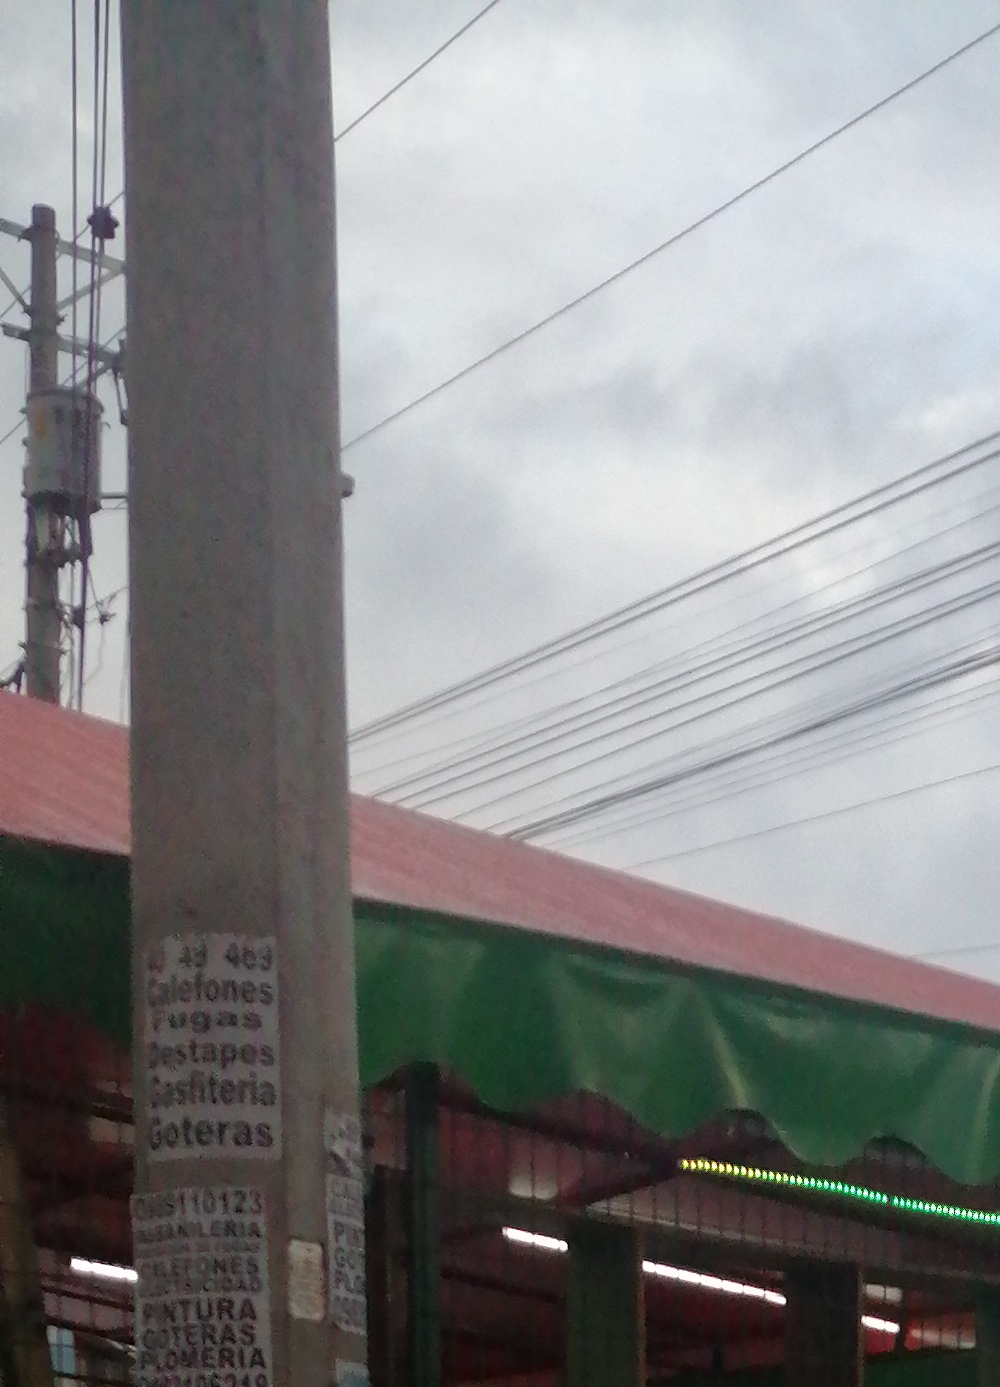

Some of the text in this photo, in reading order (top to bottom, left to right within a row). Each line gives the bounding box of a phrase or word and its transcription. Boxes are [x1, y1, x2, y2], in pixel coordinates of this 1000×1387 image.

[150, 1114, 274, 1151] Goteras
[142, 1297, 258, 1325] PINTURA
[141, 1322, 257, 1351] GOTERAS
[139, 1346, 266, 1372] PLOMERIA
